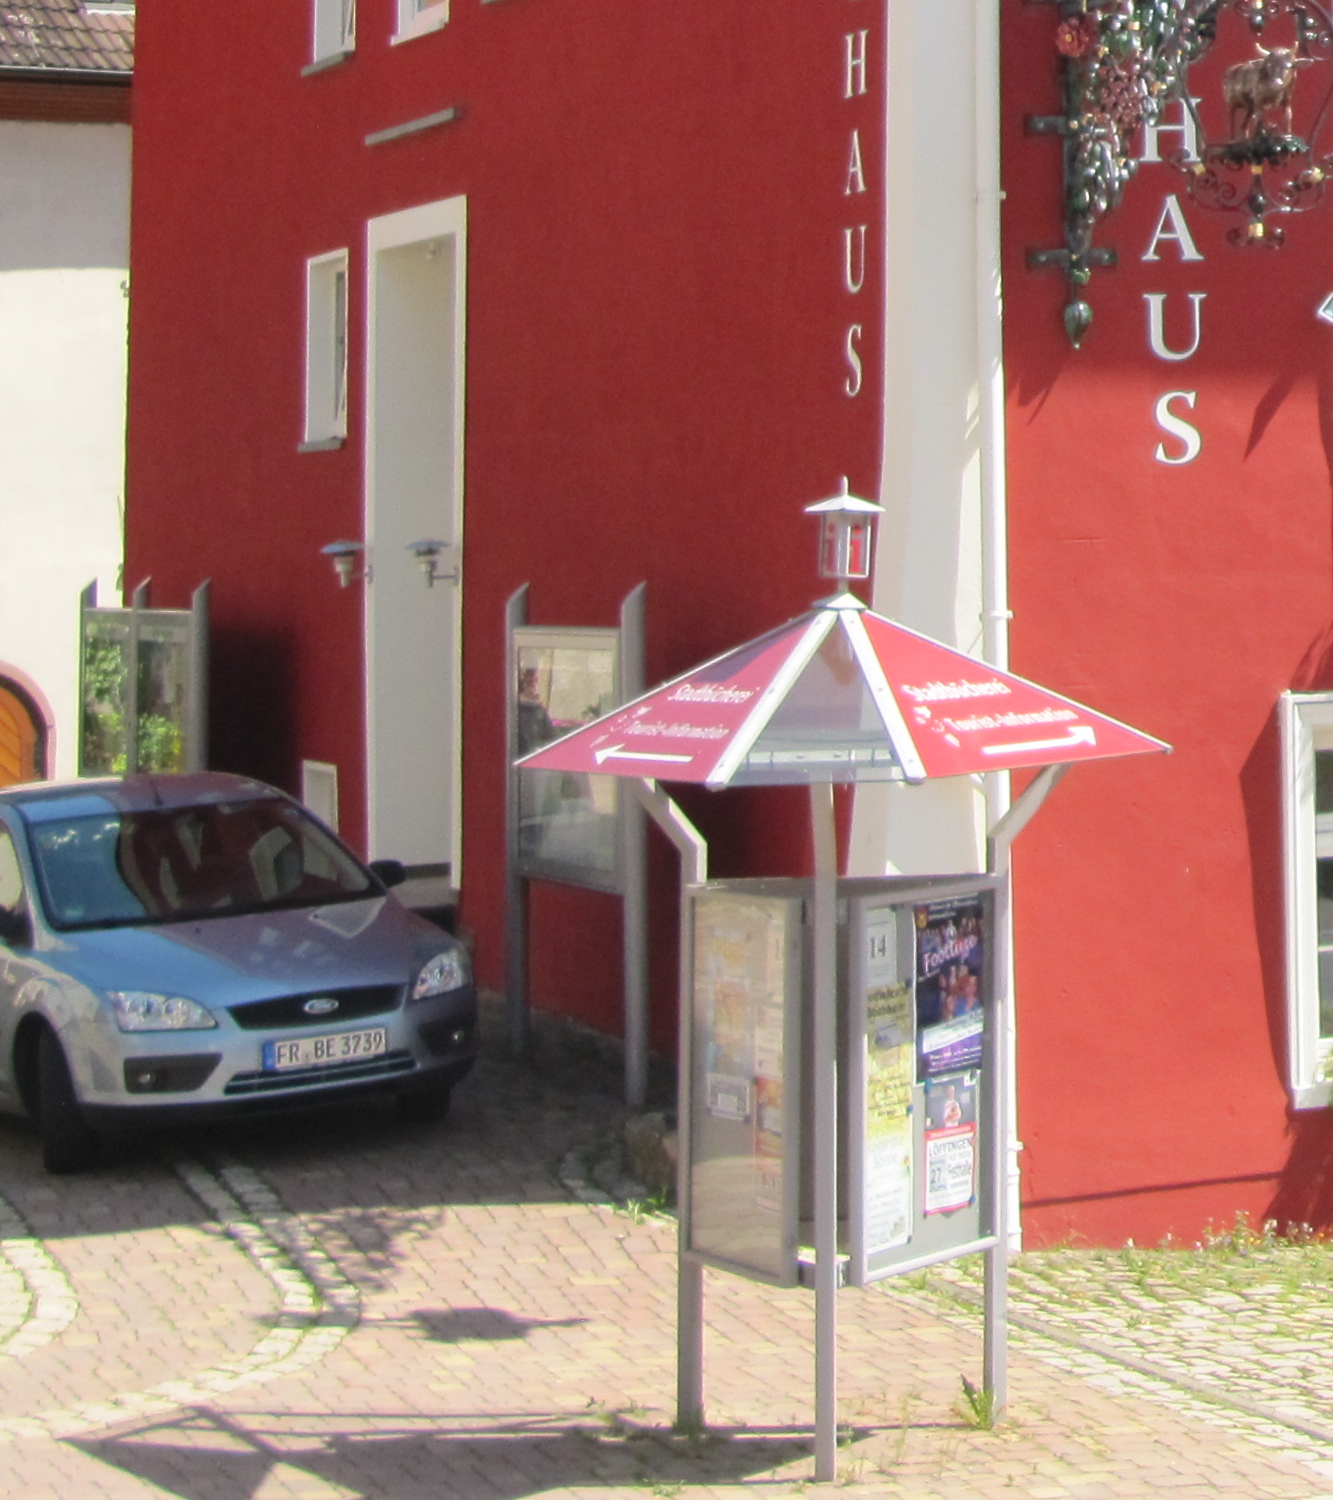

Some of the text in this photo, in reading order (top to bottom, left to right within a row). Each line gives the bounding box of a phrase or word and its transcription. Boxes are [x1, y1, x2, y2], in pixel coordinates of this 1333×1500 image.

[902, 678, 1012, 702] Stadtbücherei
[944, 707, 1079, 731] Tourist-Information
[277, 1031, 383, 1064] FR BE 3739
